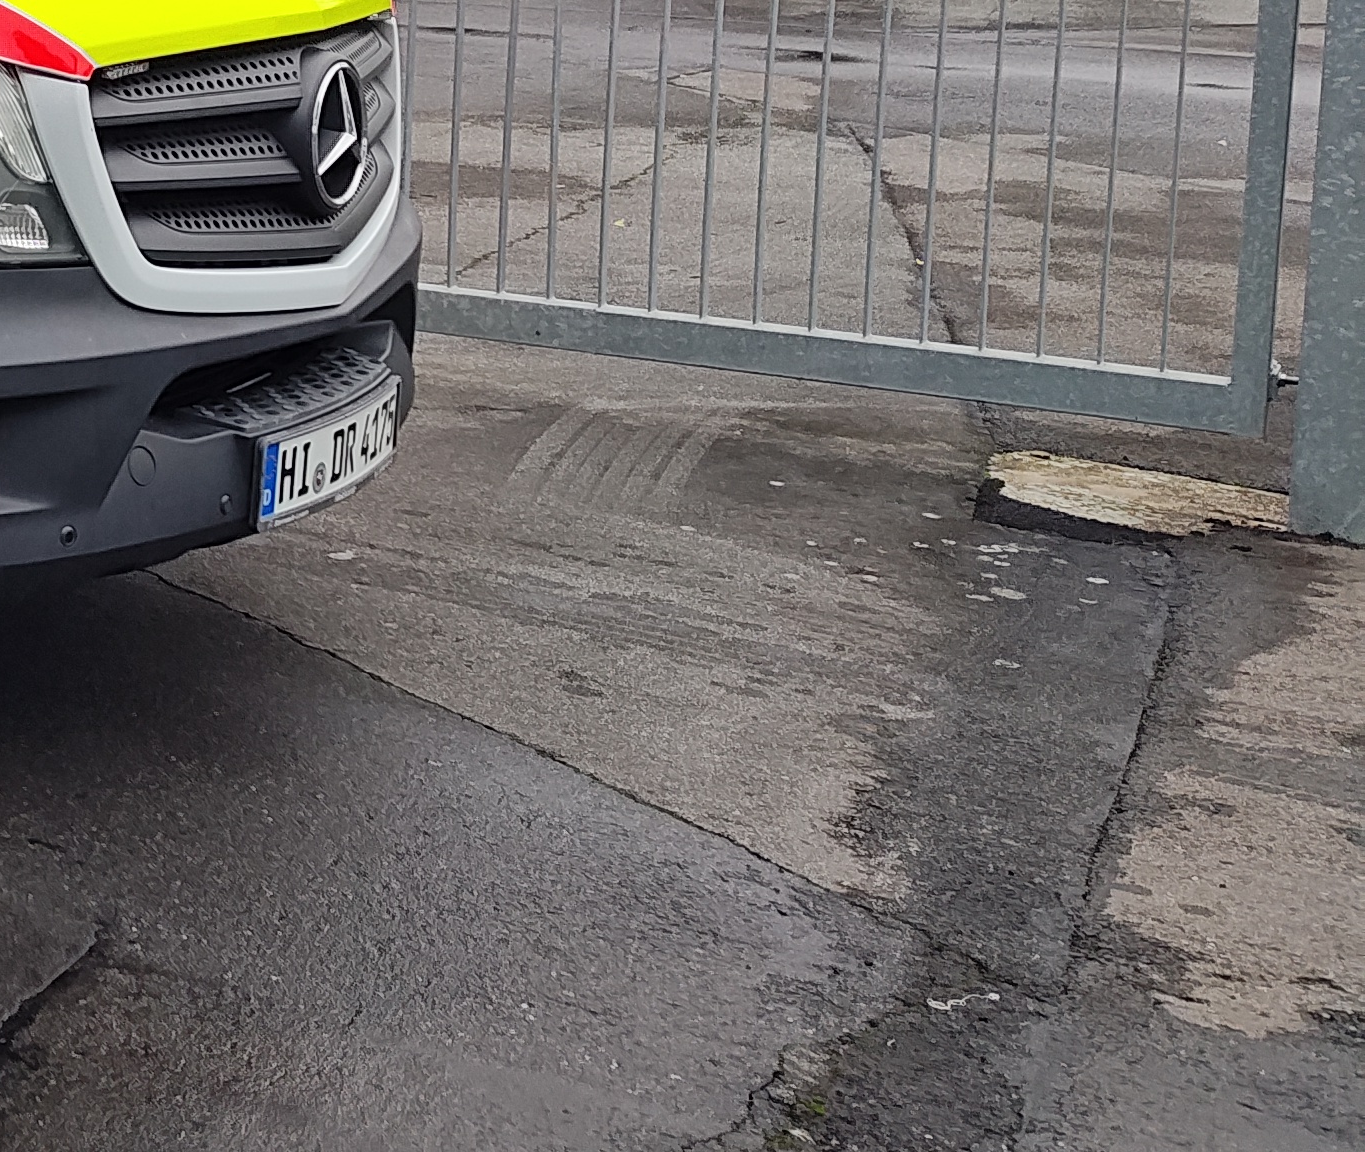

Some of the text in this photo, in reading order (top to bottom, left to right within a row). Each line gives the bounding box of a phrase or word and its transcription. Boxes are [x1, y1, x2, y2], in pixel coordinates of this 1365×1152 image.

[263, 393, 396, 506] D HI DR 4175
